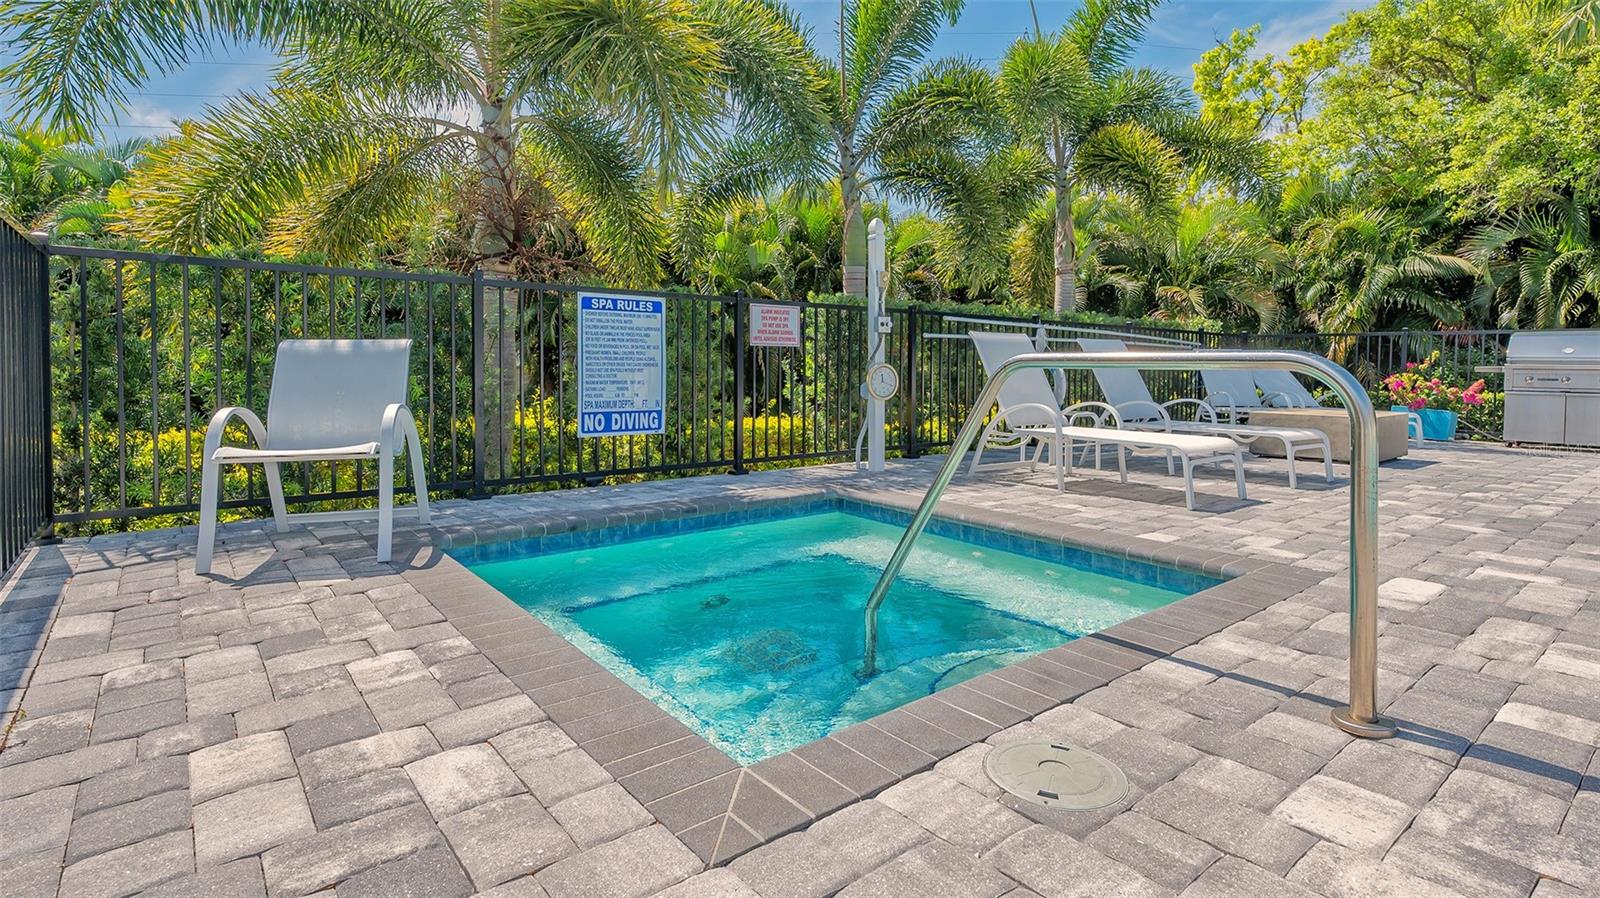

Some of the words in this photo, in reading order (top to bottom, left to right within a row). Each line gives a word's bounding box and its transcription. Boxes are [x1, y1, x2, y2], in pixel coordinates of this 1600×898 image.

[591, 298, 613, 309] SPA
[617, 300, 653, 312] RULES
[584, 400, 593, 409] SPA
[584, 414, 605, 431] NO
[611, 412, 659, 430] DIVING
